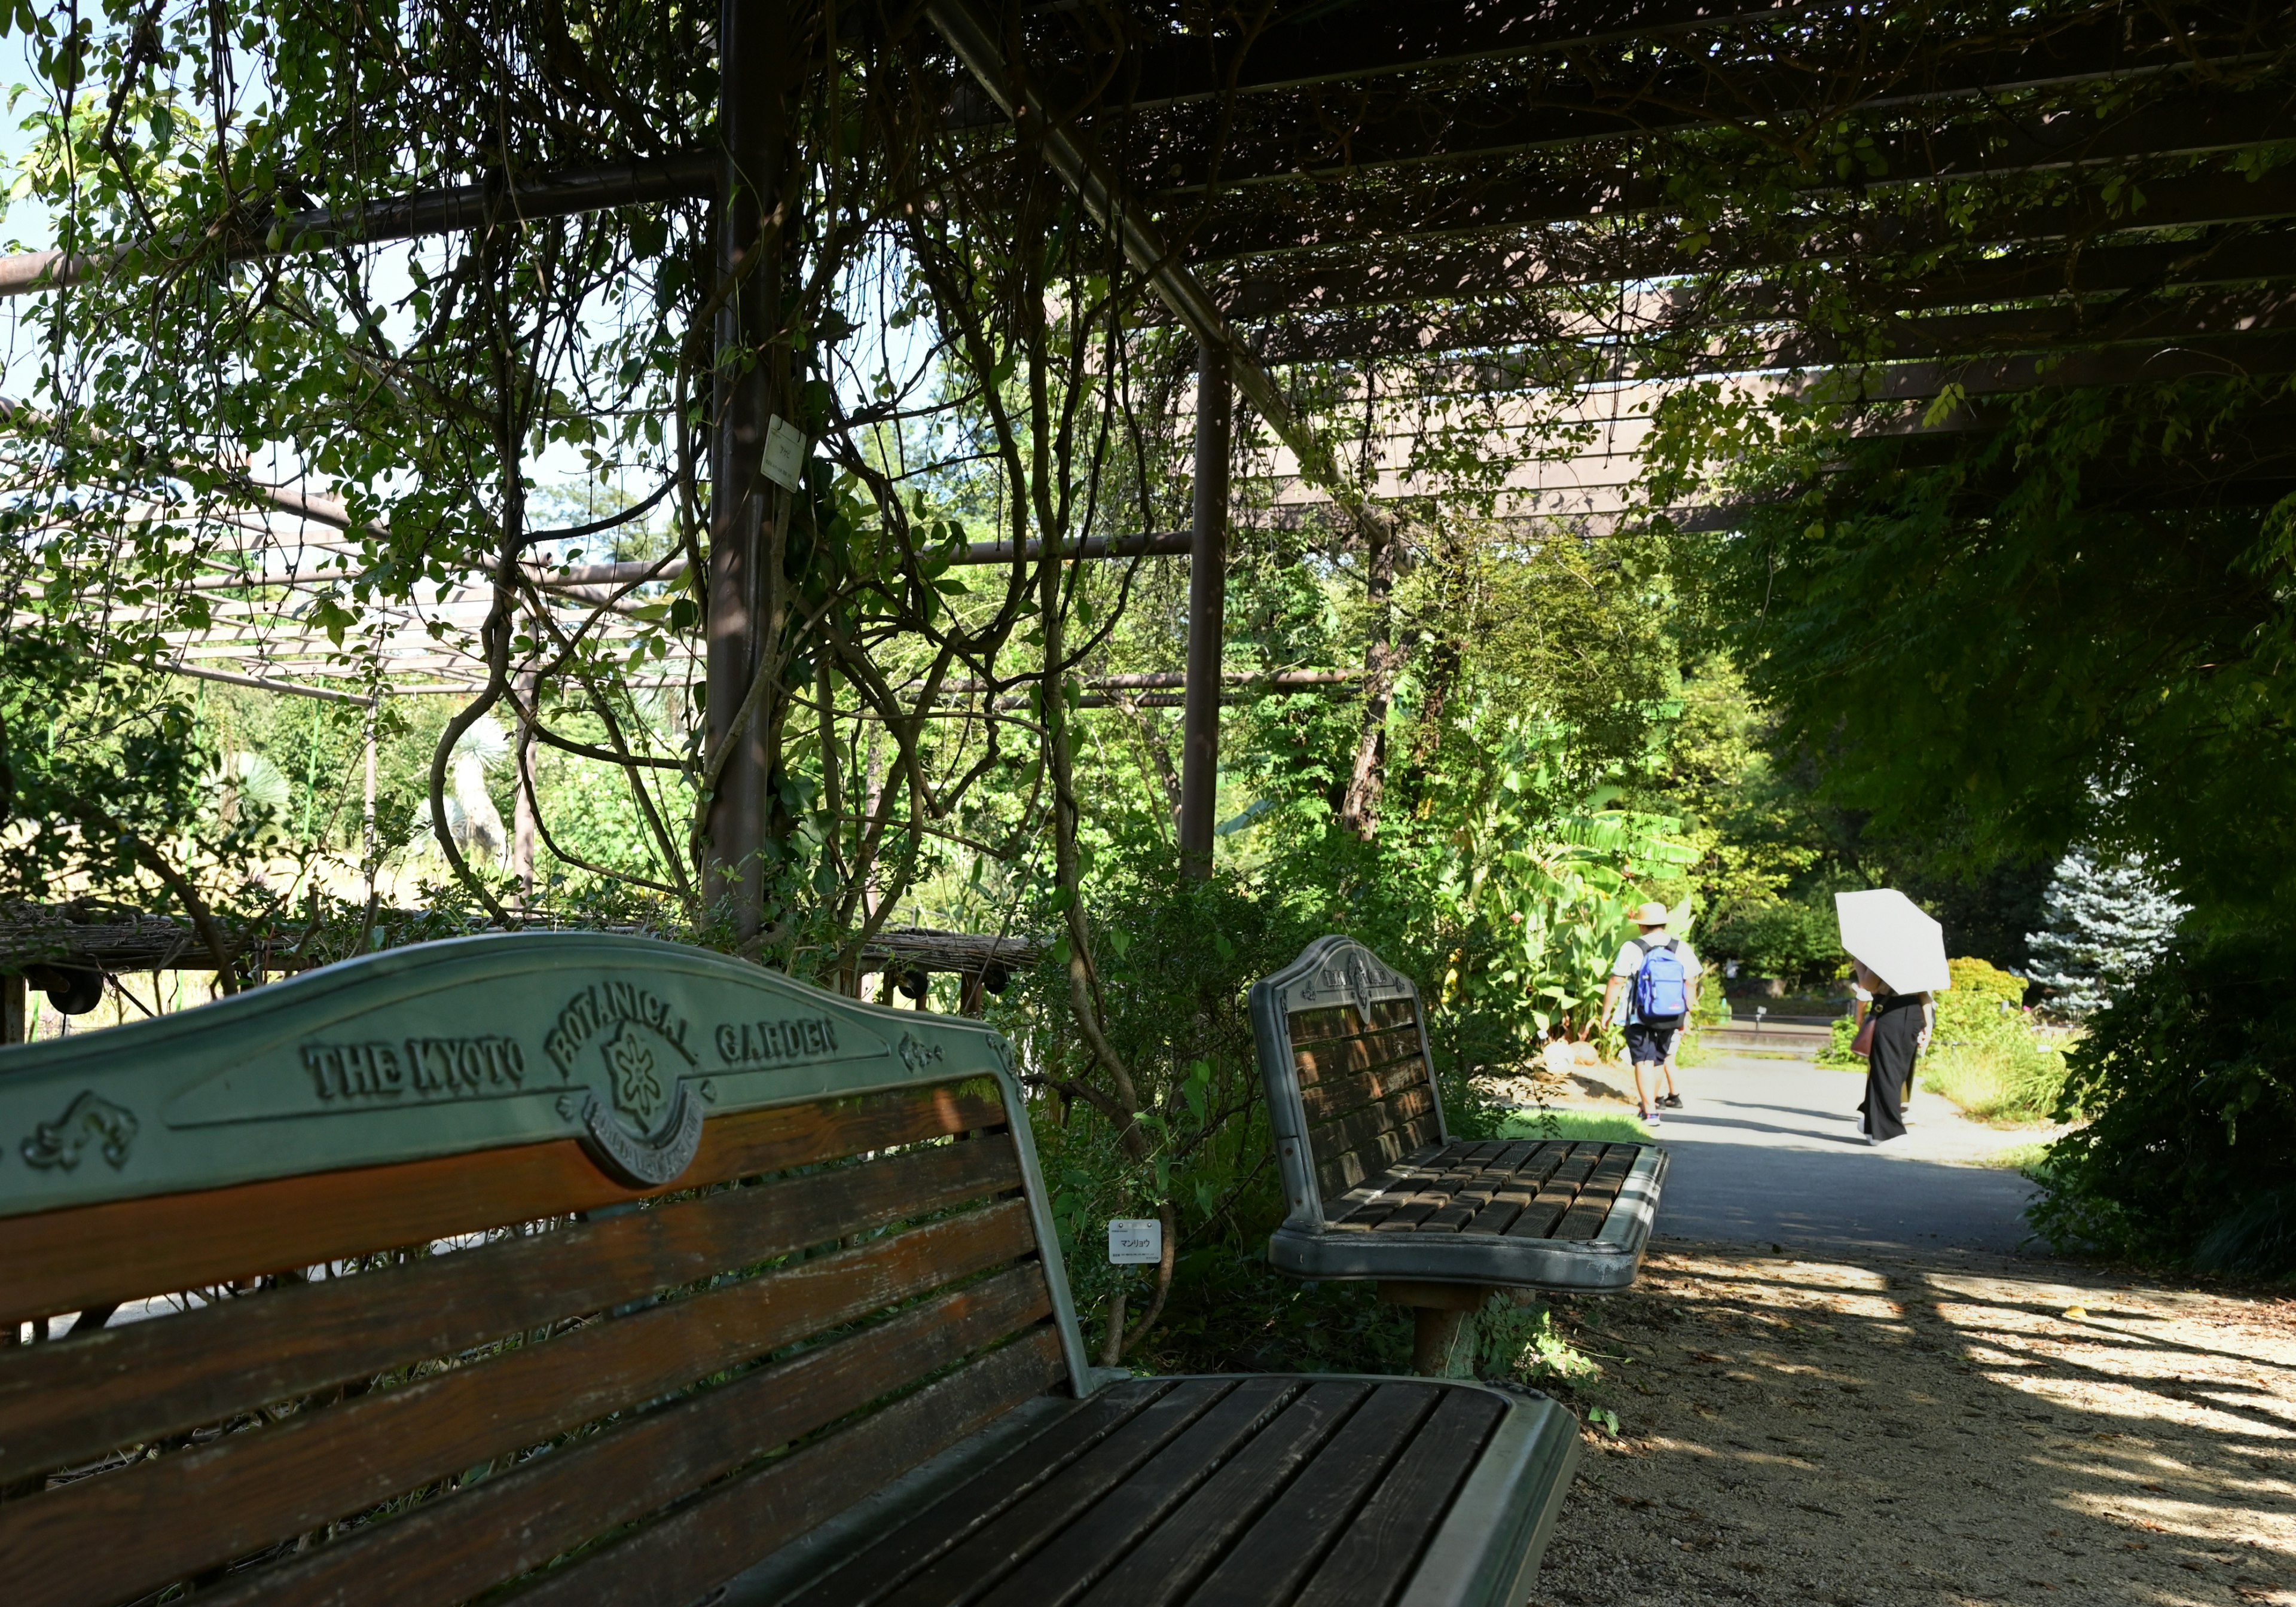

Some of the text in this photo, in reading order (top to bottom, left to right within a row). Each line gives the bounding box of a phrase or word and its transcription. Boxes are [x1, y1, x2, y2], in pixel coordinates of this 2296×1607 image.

[780, 446, 791, 459] アケビ
[306, 980, 838, 1101] THE KYOTO BOTANICAL GARDEN
[1120, 1239, 1150, 1247] マンリョウ
